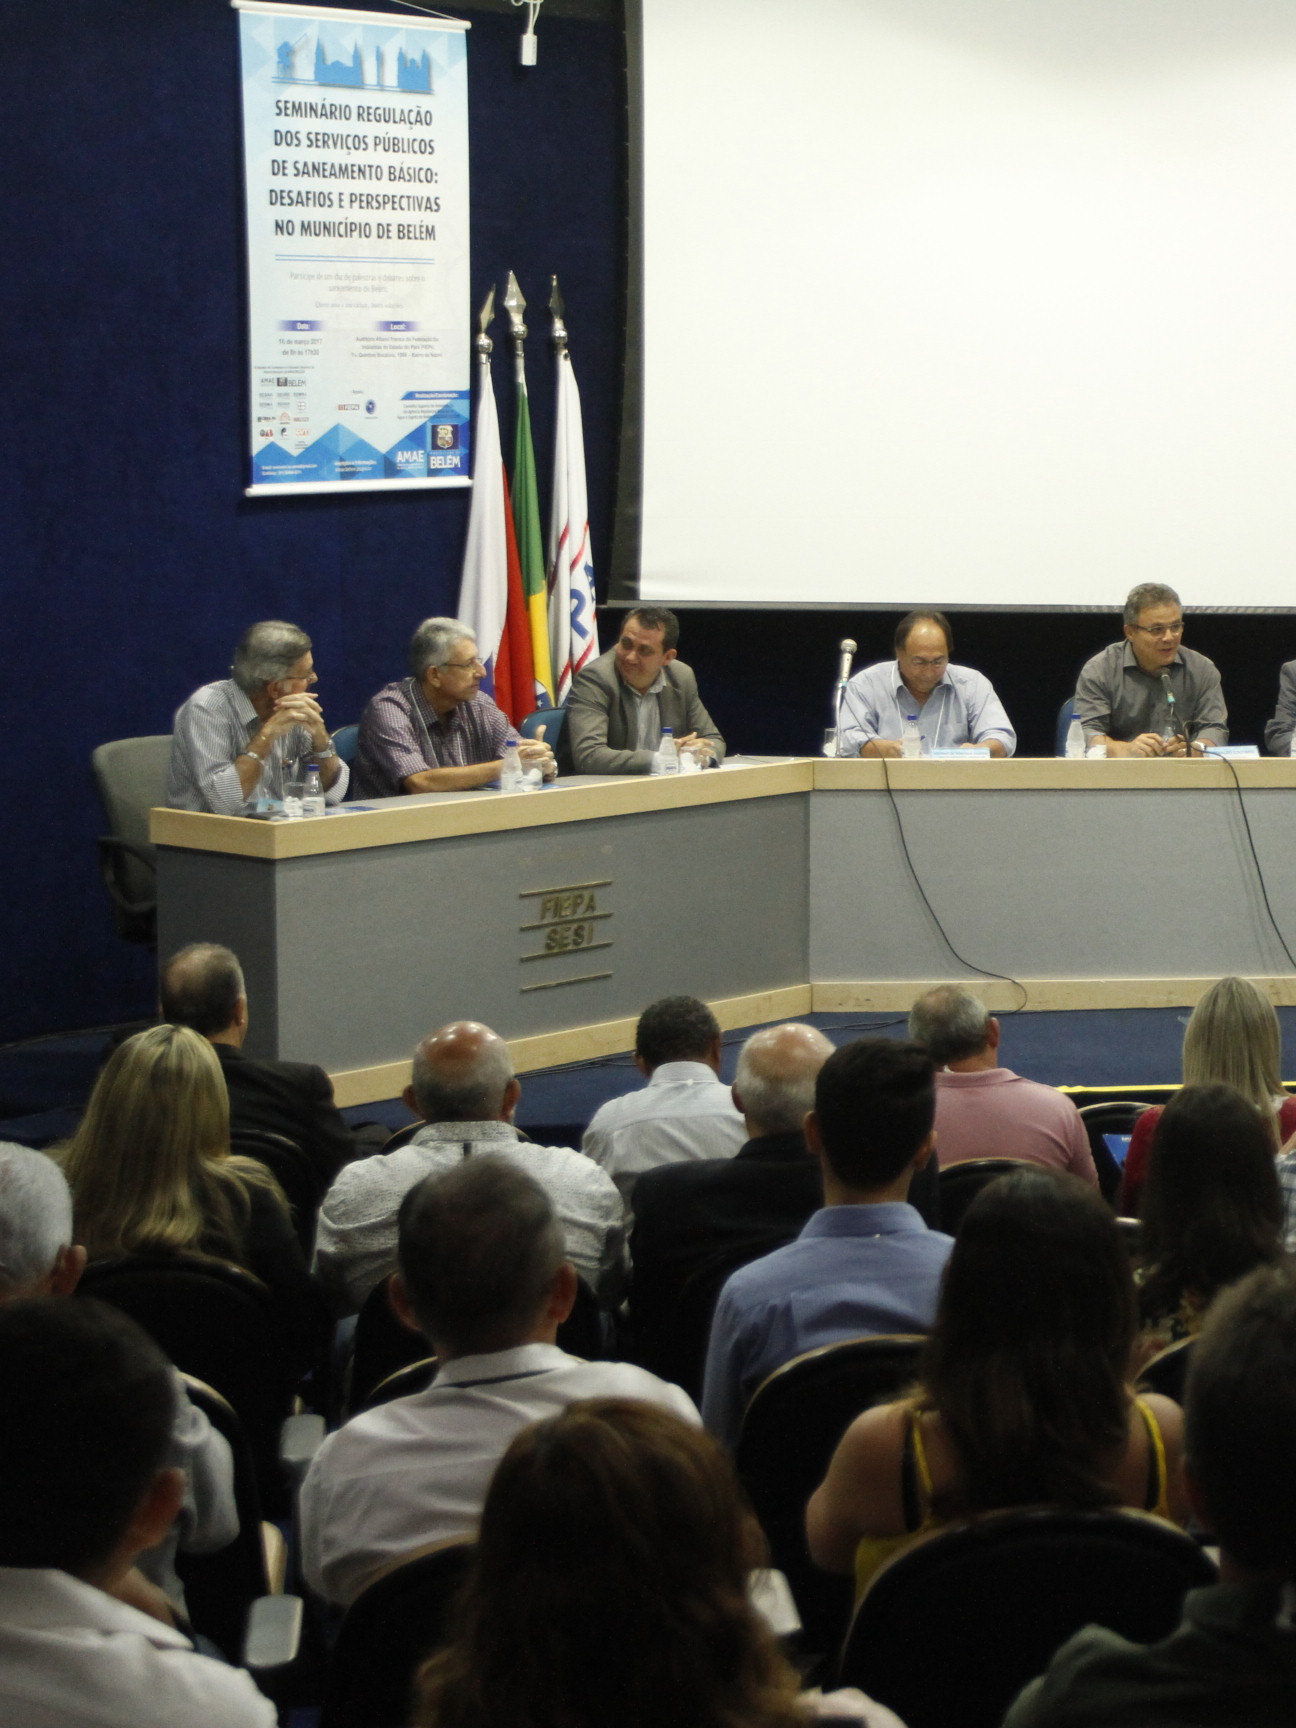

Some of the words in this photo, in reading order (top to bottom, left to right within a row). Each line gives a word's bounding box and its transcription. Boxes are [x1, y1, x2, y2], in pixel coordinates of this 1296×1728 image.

[275, 98, 351, 121] SEMINÁRIO
[357, 105, 432, 129] REGULAÇÃO
[274, 129, 301, 147] DOS
[307, 131, 368, 155] SERVIÇOS
[374, 132, 435, 155] PÚBLICOS
[271, 159, 288, 177] DE
[293, 160, 383, 182] SANEAMENTO
[388, 162, 438, 184] BÁSICO:
[269, 189, 334, 209] DESAFIOS
[338, 192, 344, 209] E
[349, 193, 441, 213] PERSPECTIVAS
[275, 219, 295, 237] NO
[300, 217, 372, 239] MUNICÍPIO
[377, 223, 392, 240] DE
[397, 220, 436, 241] BELÉM
[396, 450, 425, 463] AMAE
[430, 455, 461, 469] BELÉM
[540, 891, 597, 920] FIEPA
[544, 921, 594, 952] SESI
